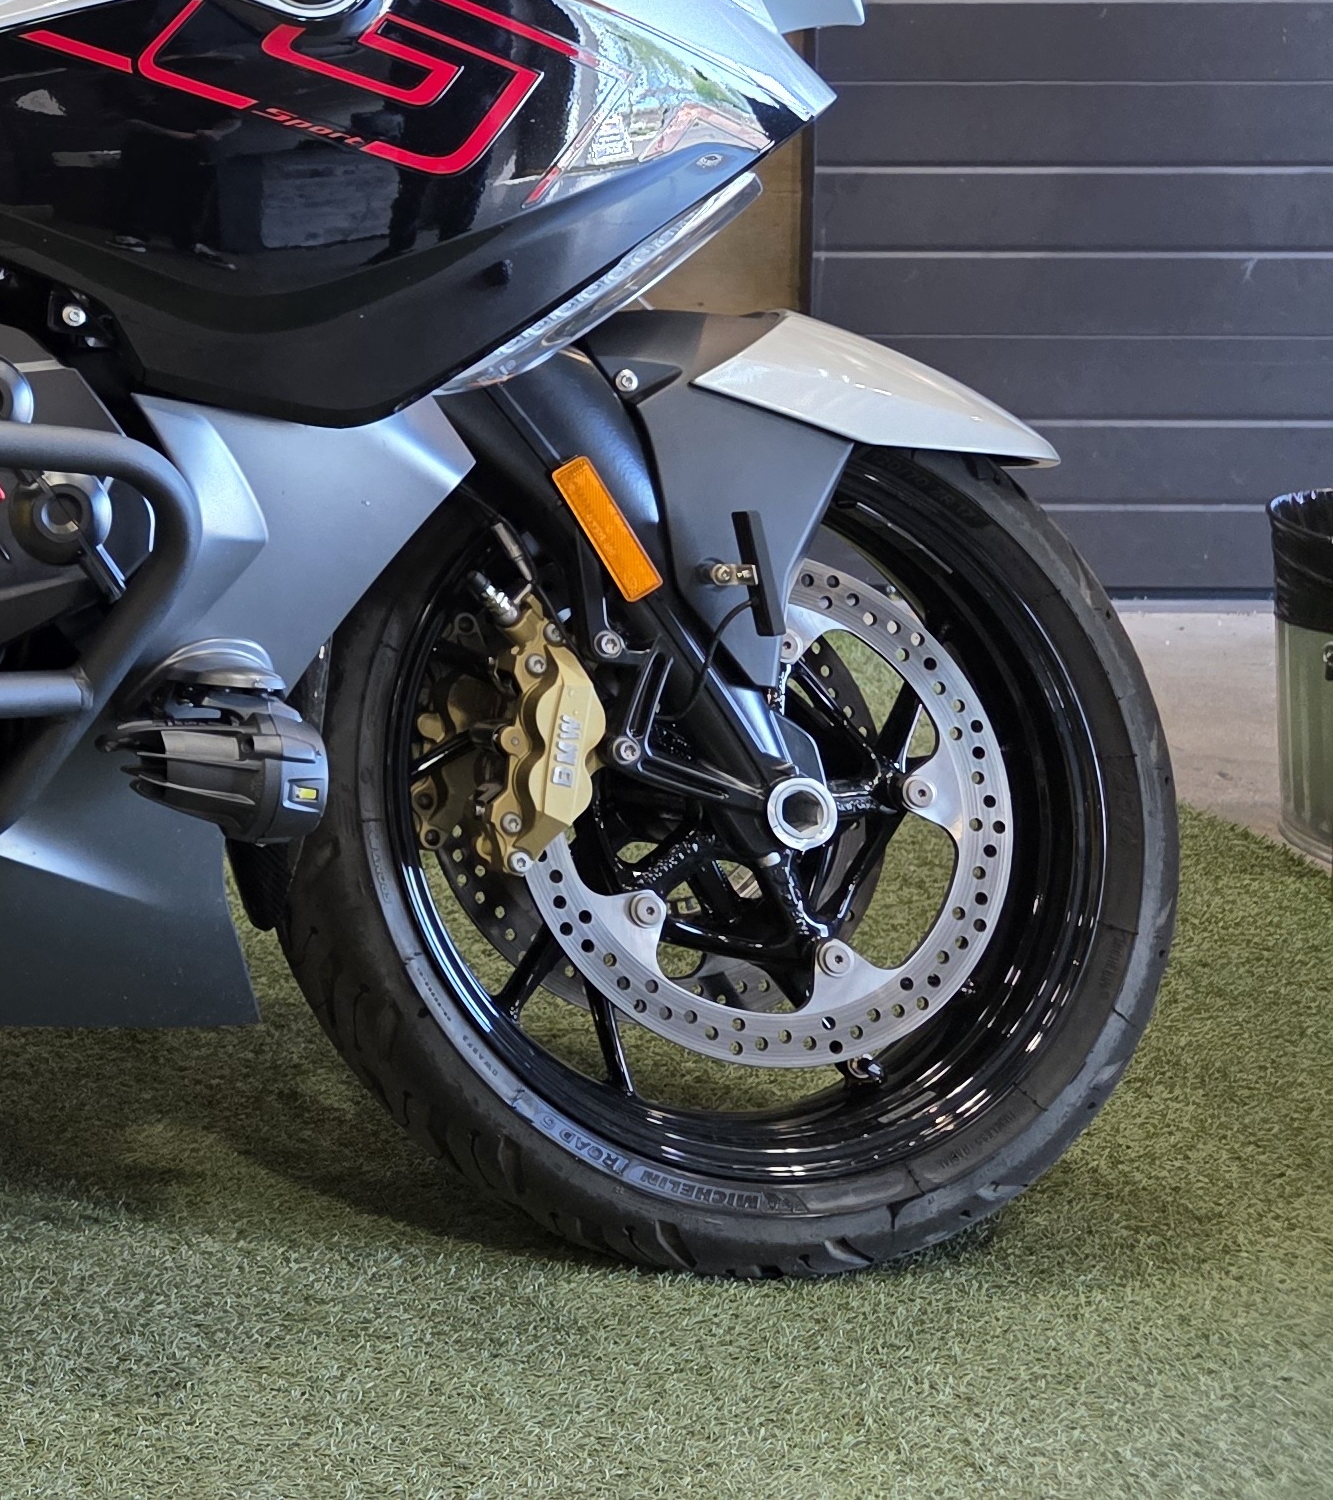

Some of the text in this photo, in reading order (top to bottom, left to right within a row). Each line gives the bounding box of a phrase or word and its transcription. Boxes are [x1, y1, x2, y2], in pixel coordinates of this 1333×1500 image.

[251, 107, 365, 146] Sport
[551, 714, 582, 788] BMW
[558, 1128, 620, 1170] ROAD
[639, 1169, 762, 1210] MICHELIN
